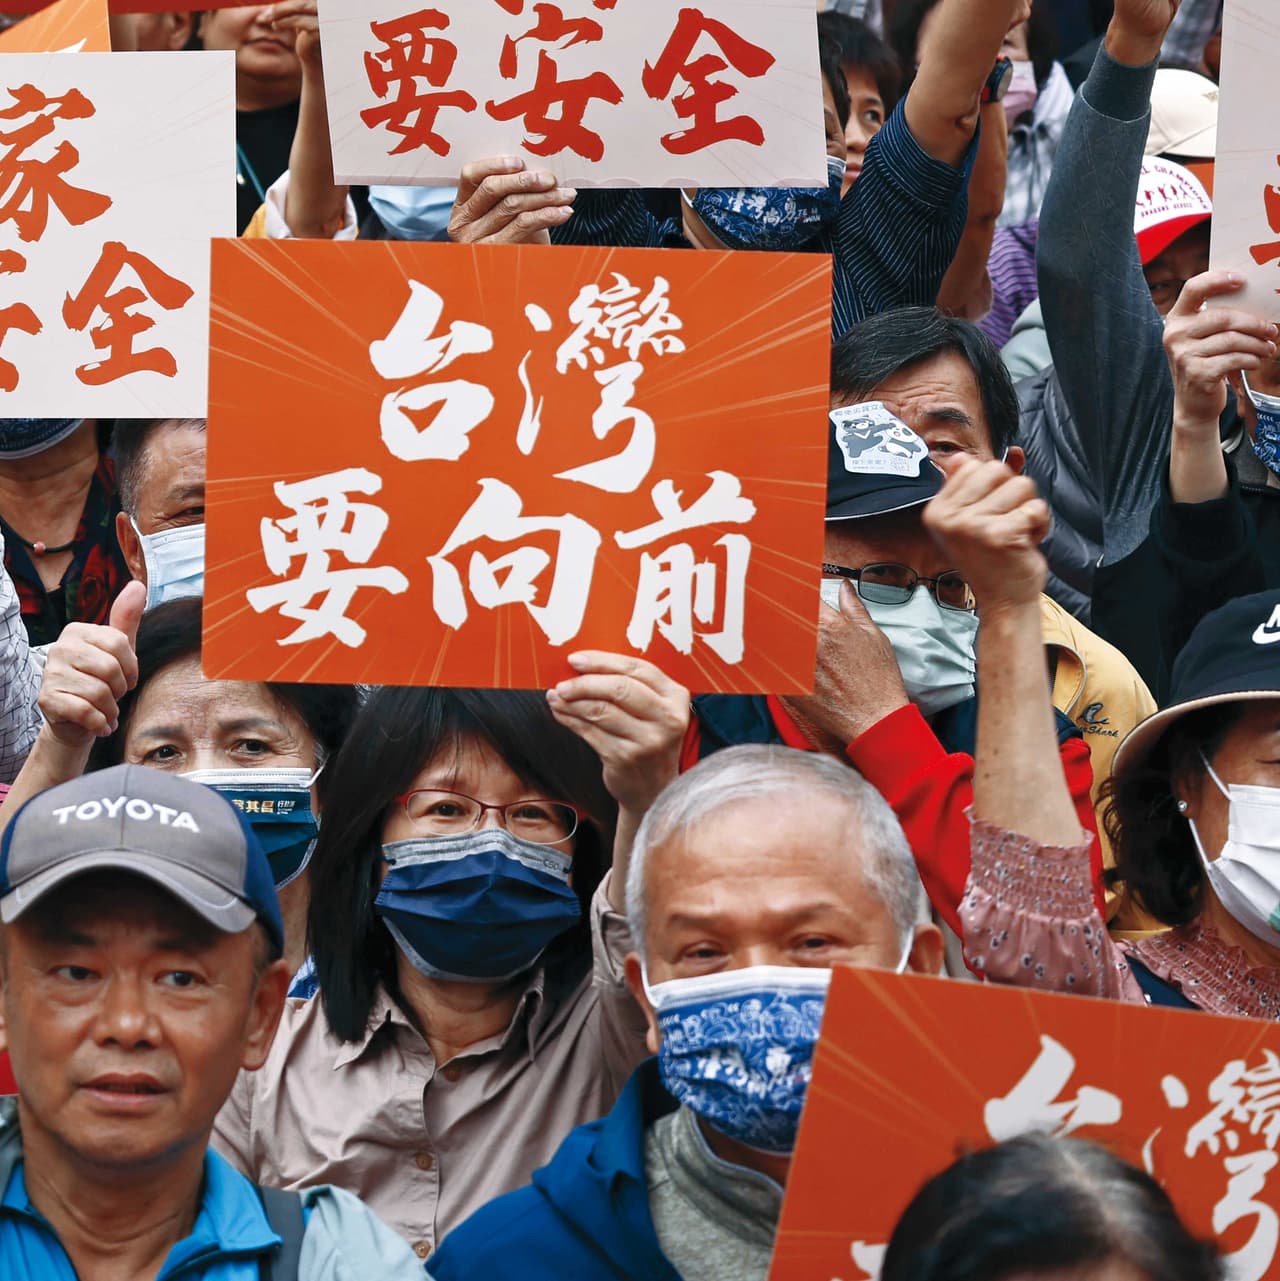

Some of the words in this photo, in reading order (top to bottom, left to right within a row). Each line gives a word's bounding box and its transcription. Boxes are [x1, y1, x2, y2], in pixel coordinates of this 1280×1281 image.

[360, 3, 776, 162] 要安全
[370, 272, 686, 494] 台灣
[246, 467, 757, 665] 要向前
[53, 796, 200, 833] TOYOTA
